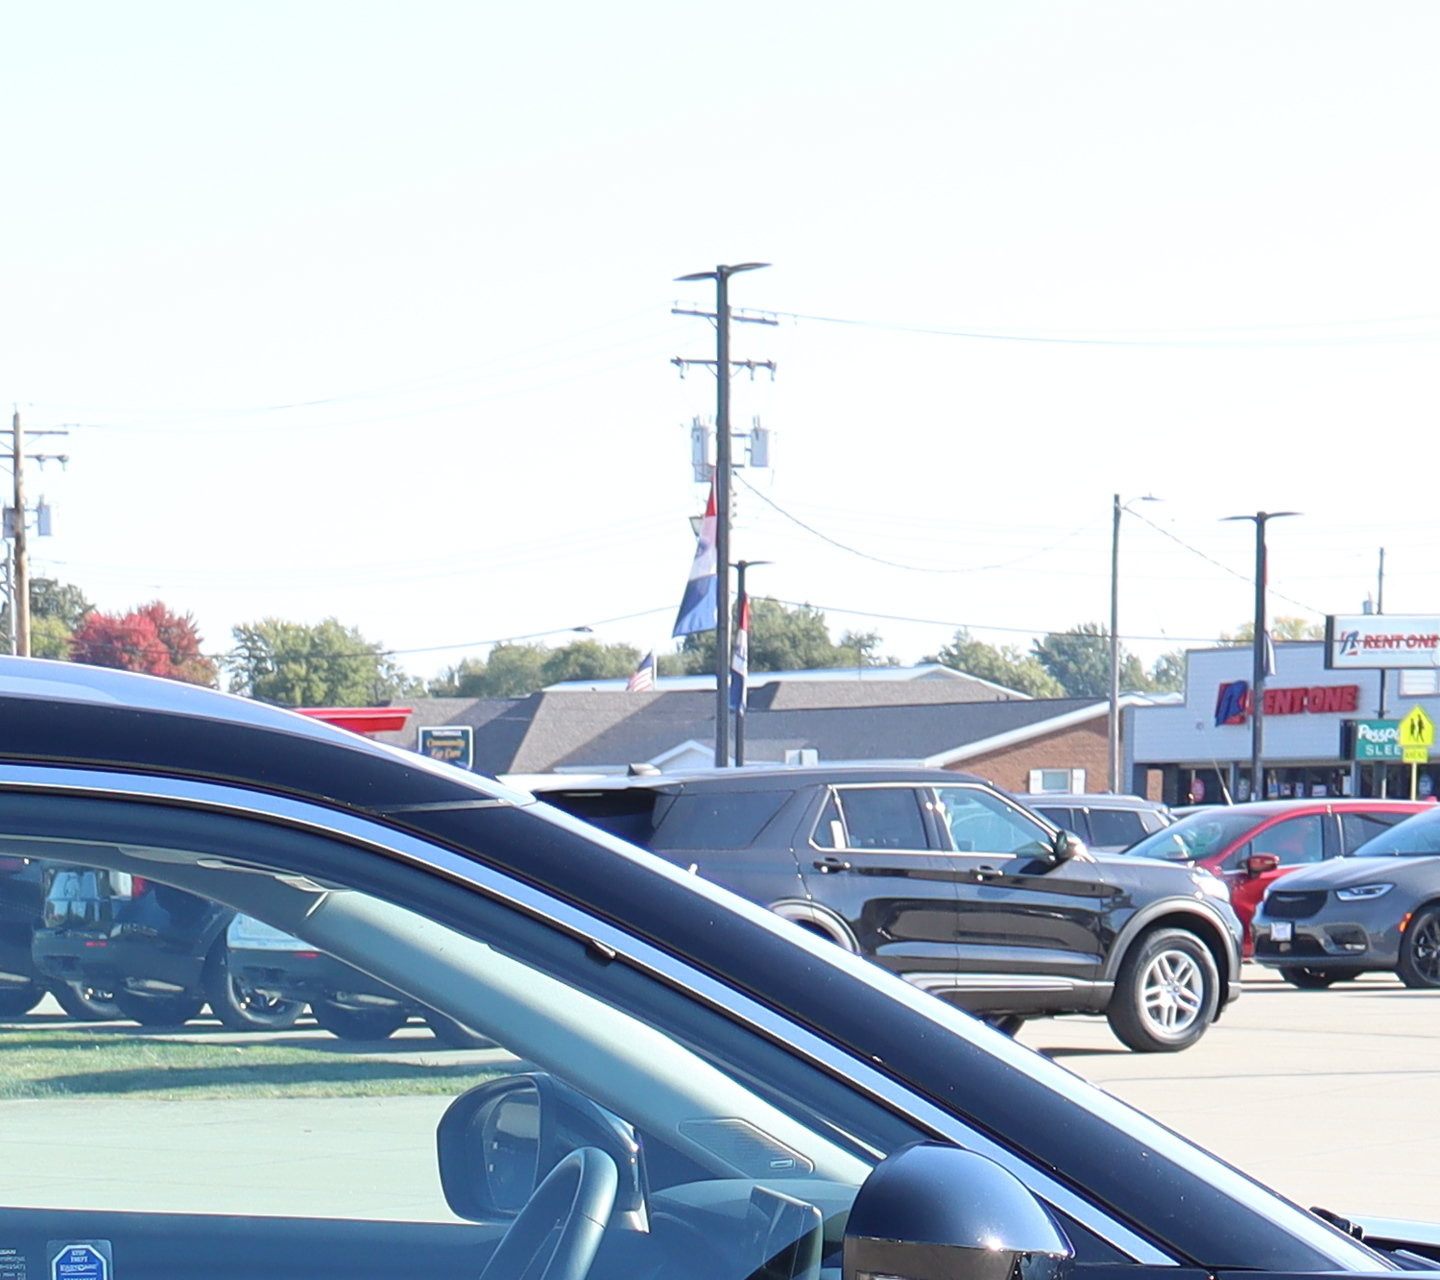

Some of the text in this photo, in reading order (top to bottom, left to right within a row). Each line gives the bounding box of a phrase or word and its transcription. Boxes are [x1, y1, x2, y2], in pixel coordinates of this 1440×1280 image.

[1363, 634, 1440, 649] RENT ONE
[1309, 685, 1359, 714] ONE
